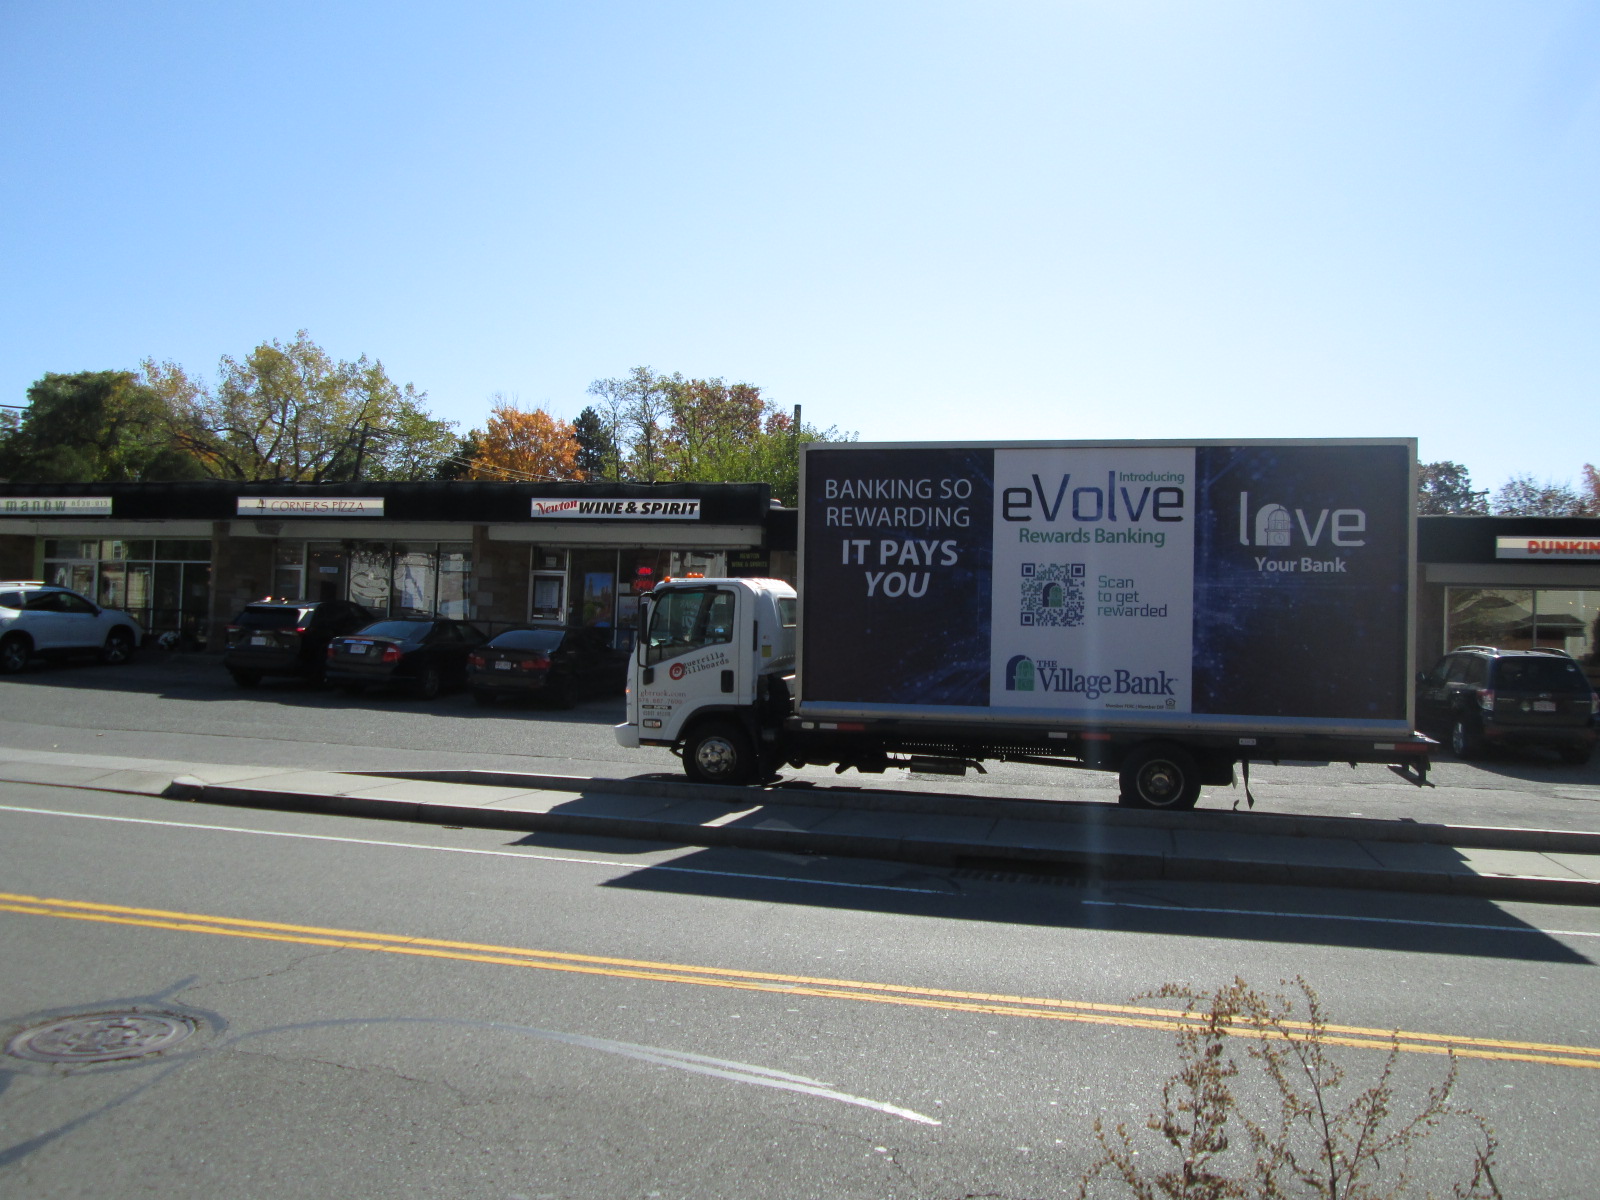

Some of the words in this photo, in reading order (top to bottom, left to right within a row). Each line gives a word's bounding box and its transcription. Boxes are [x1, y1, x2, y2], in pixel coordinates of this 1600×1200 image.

[1119, 471, 1185, 484] Introducing
[825, 479, 932, 499] BANKING
[940, 478, 972, 499] SO
[1002, 470, 1184, 523] eVolve
[6, 500, 66, 512] manow
[271, 501, 328, 513] CORNERS
[332, 500, 365, 513] PIZZA
[536, 500, 577, 515] Newton
[578, 502, 624, 514] WINE
[625, 501, 637, 514] &
[640, 502, 698, 515] SPIRIT
[826, 506, 970, 527] REWARDING
[1019, 527, 1090, 543] Rewards
[1094, 527, 1165, 548] Banking
[842, 539, 871, 565] IT
[879, 539, 958, 566] PAYS
[1254, 556, 1297, 572] Your
[1300, 556, 1347, 573] Bank
[865, 571, 930, 598] YOU
[1098, 575, 1134, 589] Scan
[1097, 590, 1112, 602] to
[1116, 590, 1140, 607] get
[1097, 603, 1168, 618] rewarded
[1036, 660, 1058, 668] THE
[1036, 668, 1111, 700] Village
[1113, 669, 1175, 696] Bank
